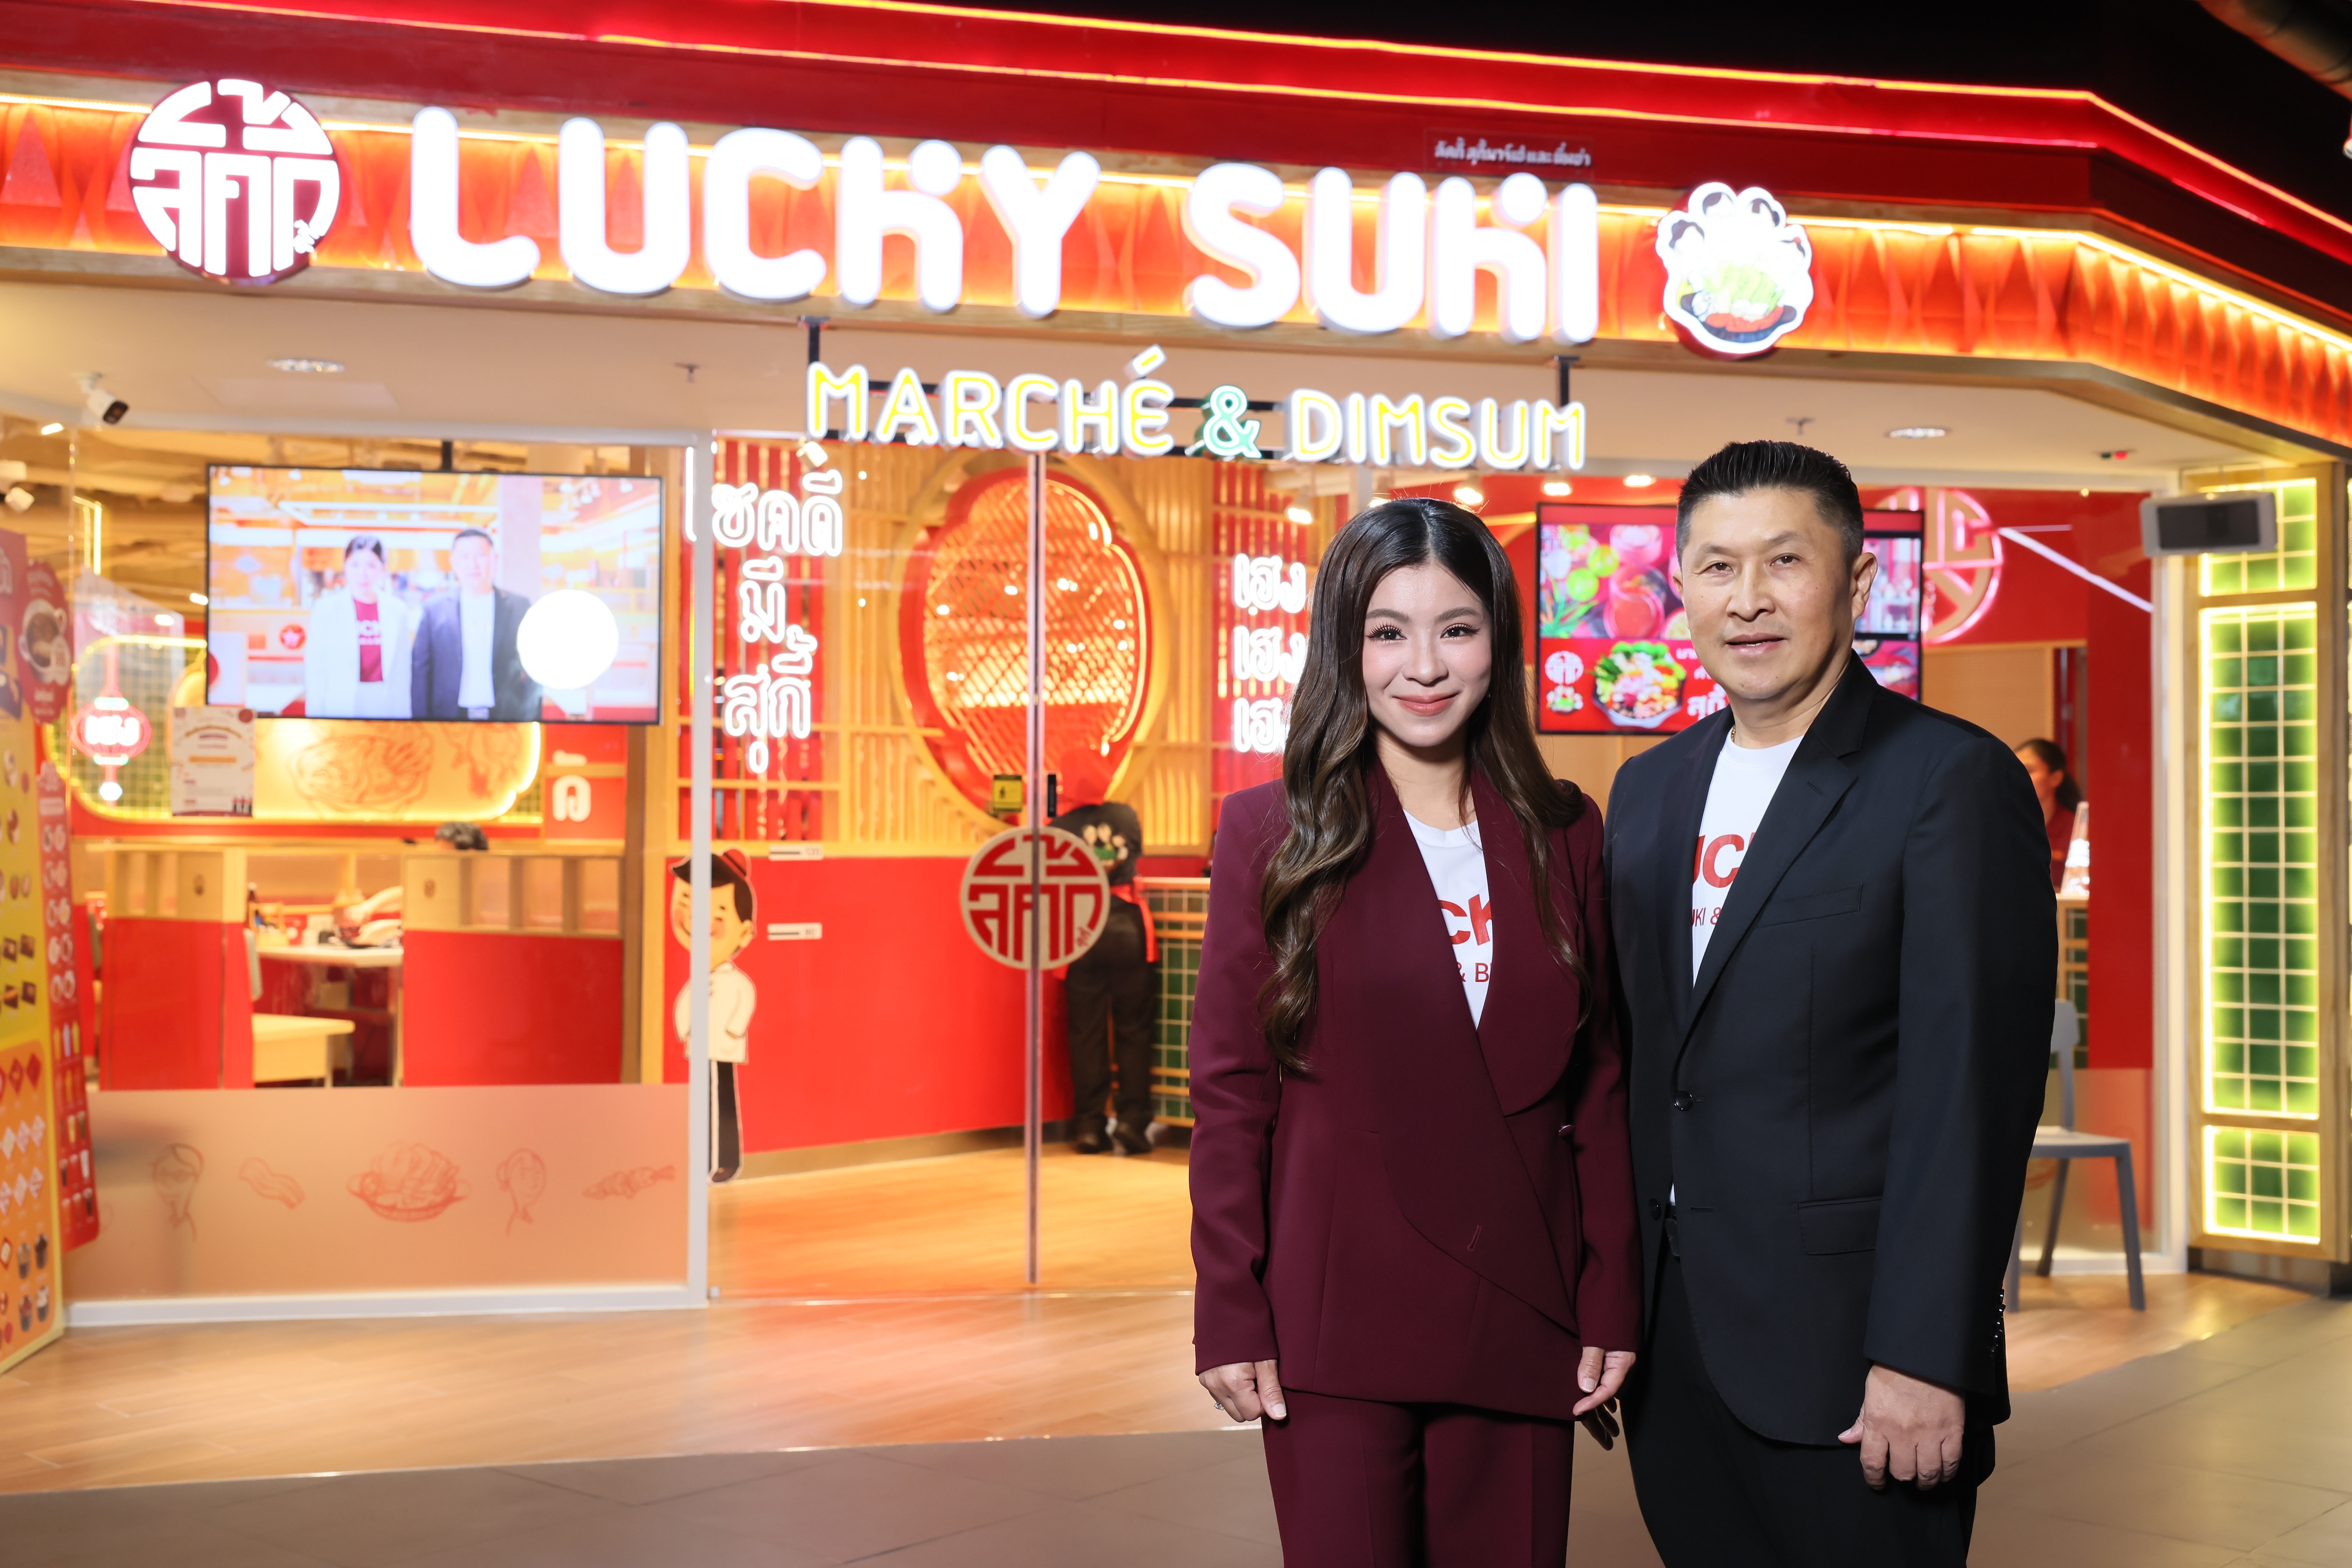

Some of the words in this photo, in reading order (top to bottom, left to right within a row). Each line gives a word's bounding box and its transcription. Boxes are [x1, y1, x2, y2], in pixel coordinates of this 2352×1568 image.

[411, 106, 1101, 316] LUCKY
[1184, 162, 1599, 344] SUKI
[806, 344, 1175, 456] MARCHÉ
[1203, 385, 1262, 458] &
[1286, 388, 1585, 470] DIMSUM
[739, 556, 786, 643] มี
[724, 624, 817, 774] สุกี้
